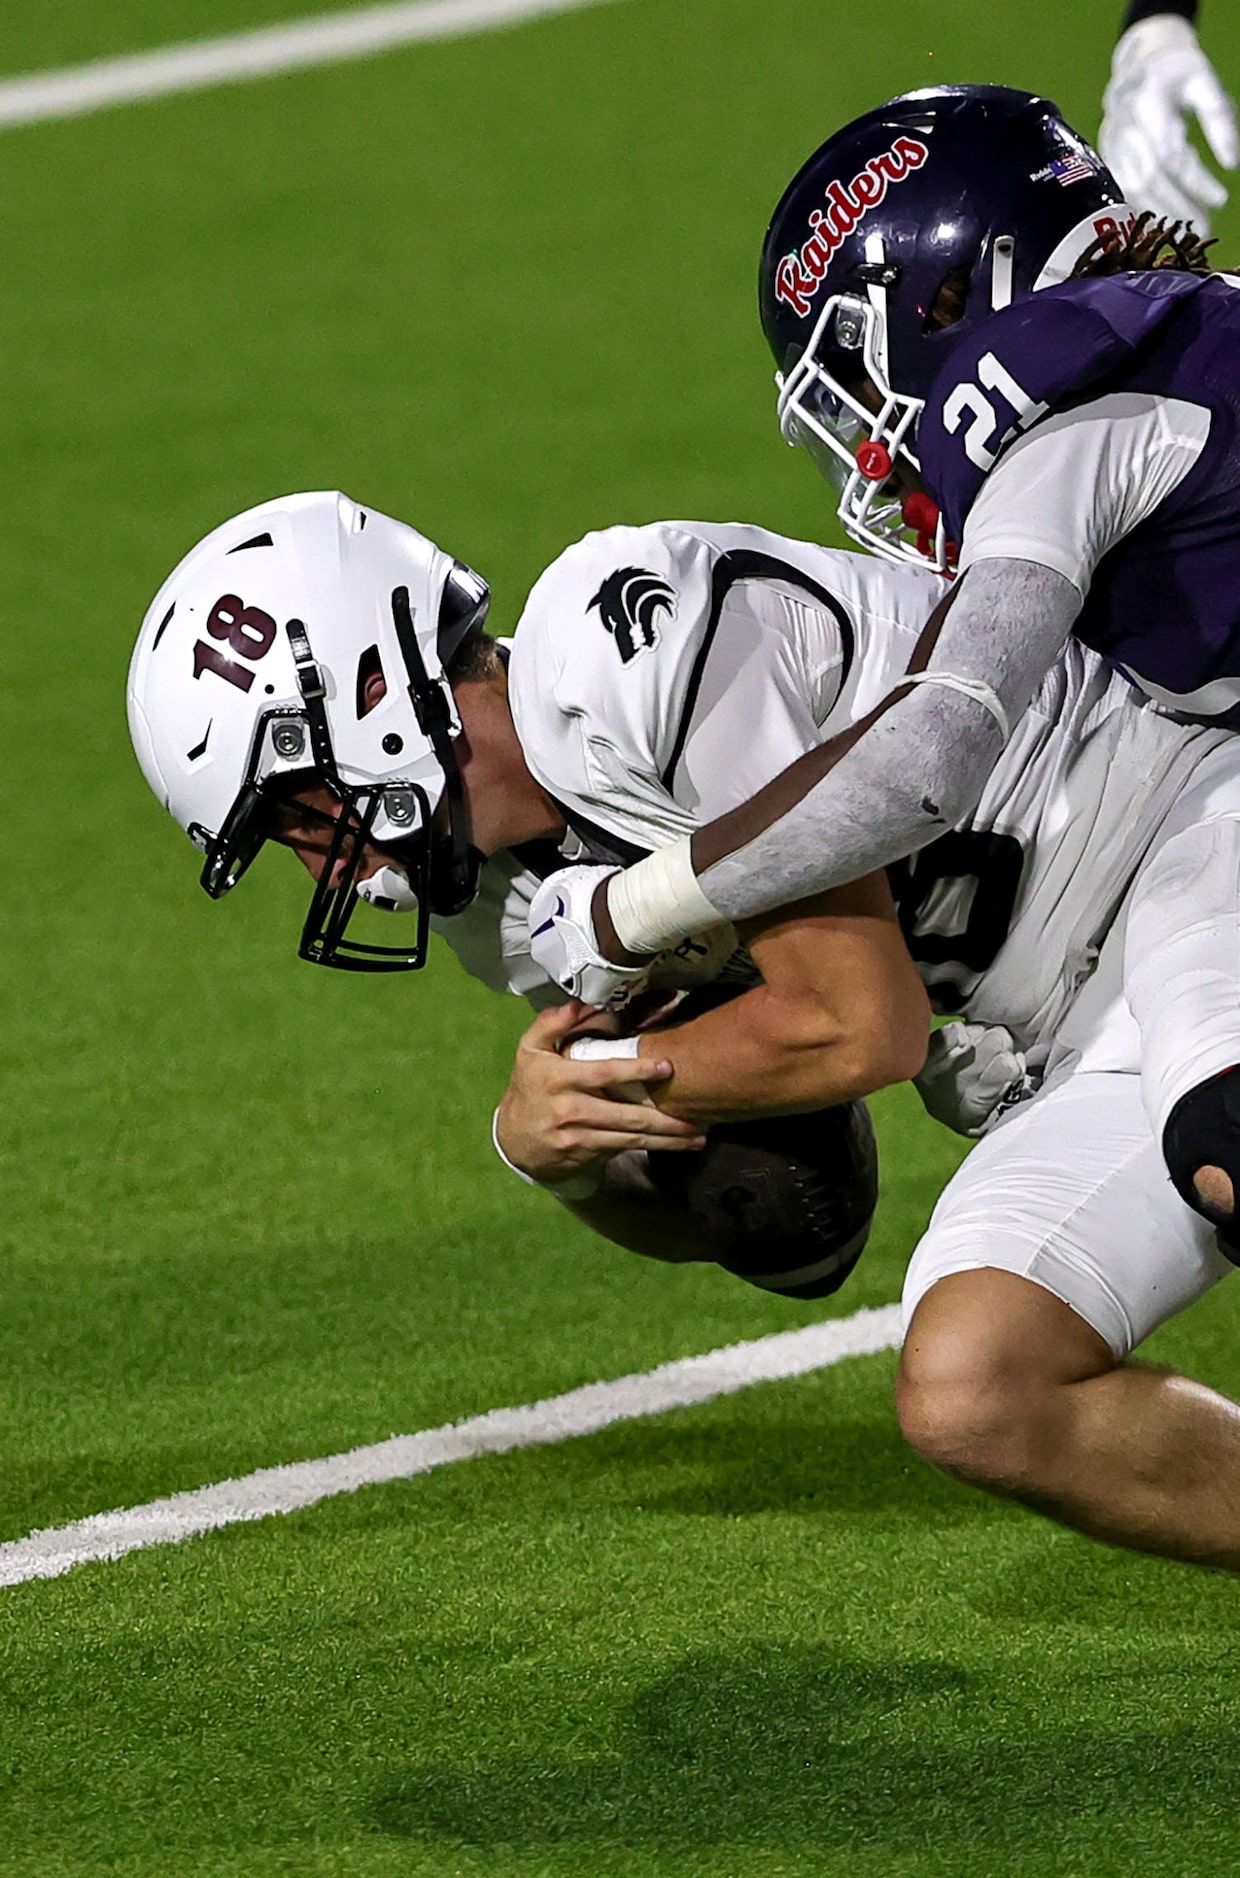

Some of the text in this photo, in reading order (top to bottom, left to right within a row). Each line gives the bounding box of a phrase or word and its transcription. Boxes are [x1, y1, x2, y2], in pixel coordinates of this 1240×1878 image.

[775, 136, 929, 317] Raiders
[942, 351, 1050, 473] 21
[191, 593, 278, 694] 18
